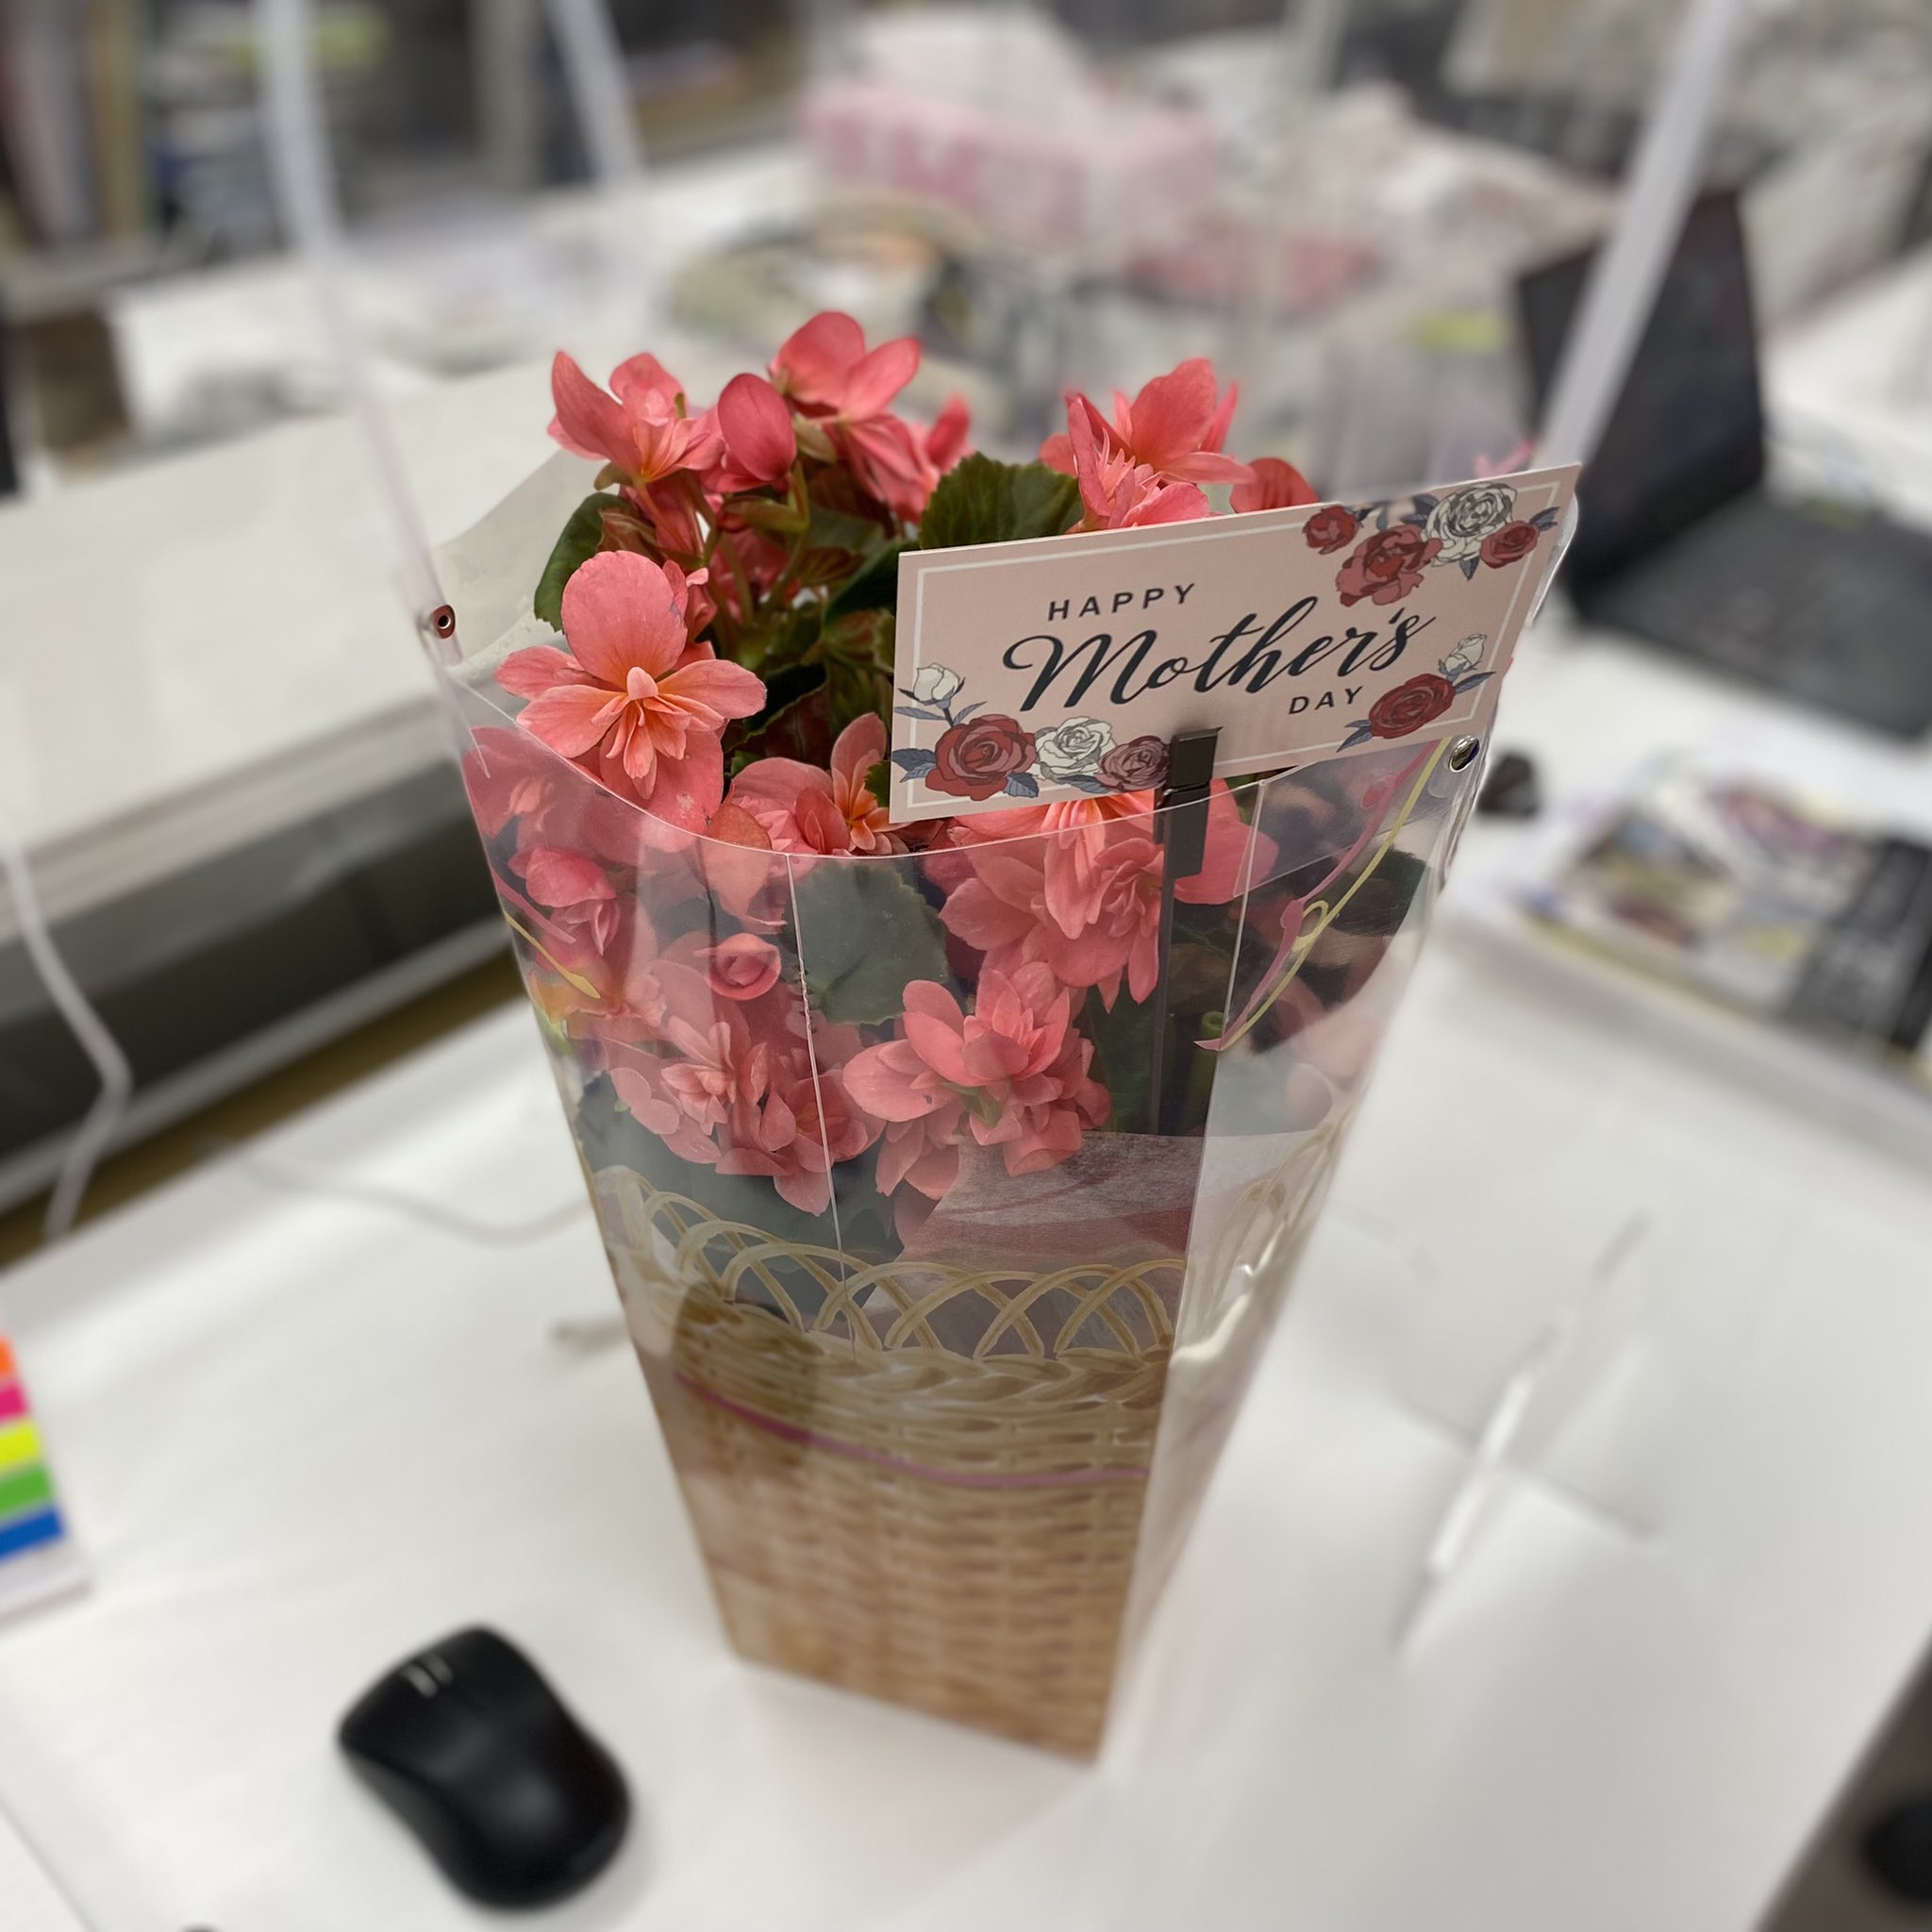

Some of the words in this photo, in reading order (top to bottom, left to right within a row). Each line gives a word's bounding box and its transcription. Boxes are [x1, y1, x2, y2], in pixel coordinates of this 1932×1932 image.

[1047, 583, 1196, 622] HAPPY
[1002, 596, 1437, 712] Mother's
[1288, 686, 1363, 715] DAY
